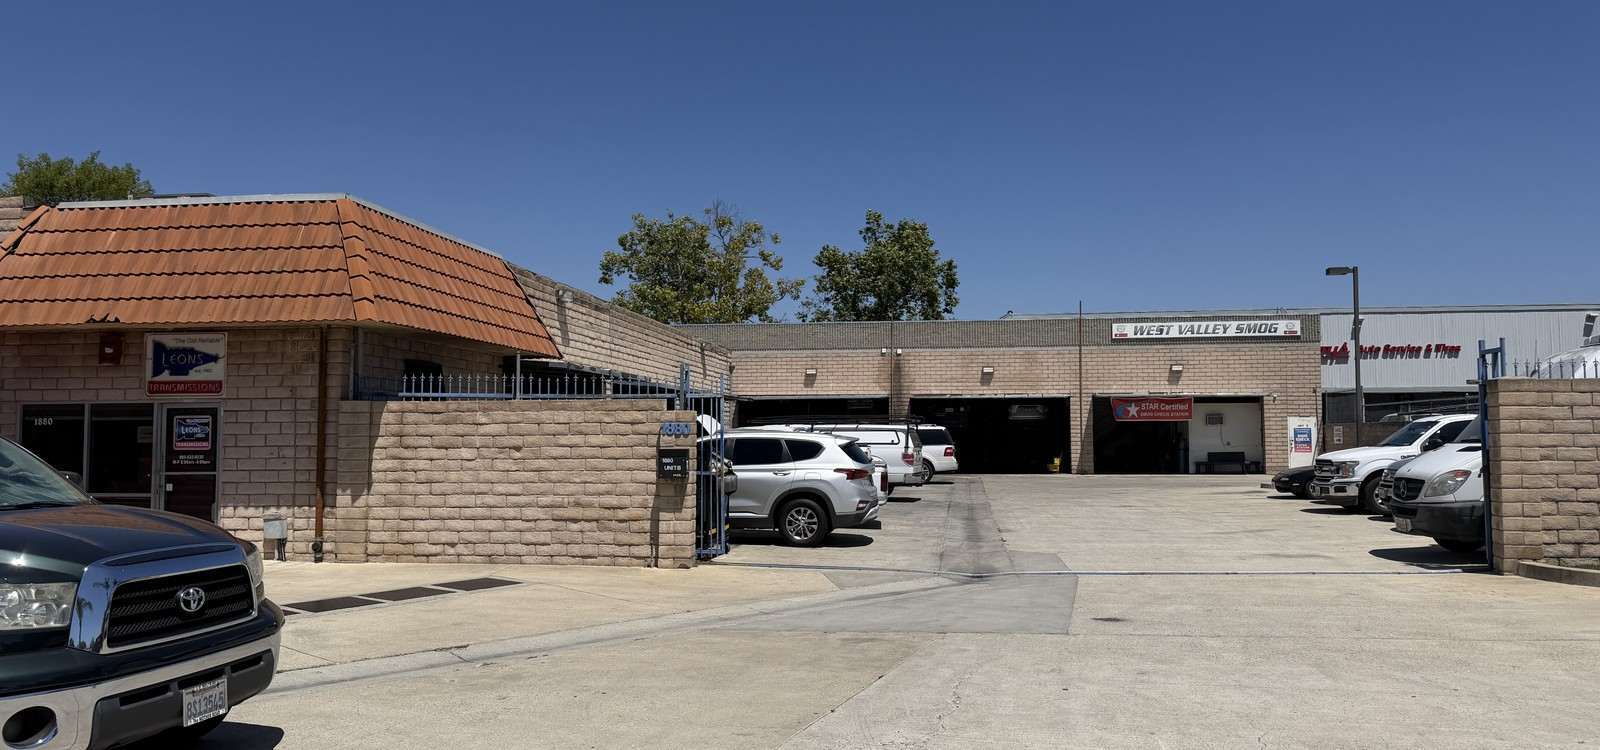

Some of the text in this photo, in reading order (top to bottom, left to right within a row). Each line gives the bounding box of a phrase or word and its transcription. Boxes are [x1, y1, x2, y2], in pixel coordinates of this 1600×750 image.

[1133, 324, 1174, 336] WEST
[1178, 323, 1231, 335] VALLEY
[1234, 322, 1279, 334] SMOG
[1382, 343, 1422, 353] Service
[1434, 343, 1461, 353] Tires
[161, 351, 204, 368] LEONS
[149, 382, 221, 393] TRANSMISSIONS
[1141, 402, 1189, 411] STAR Certified
